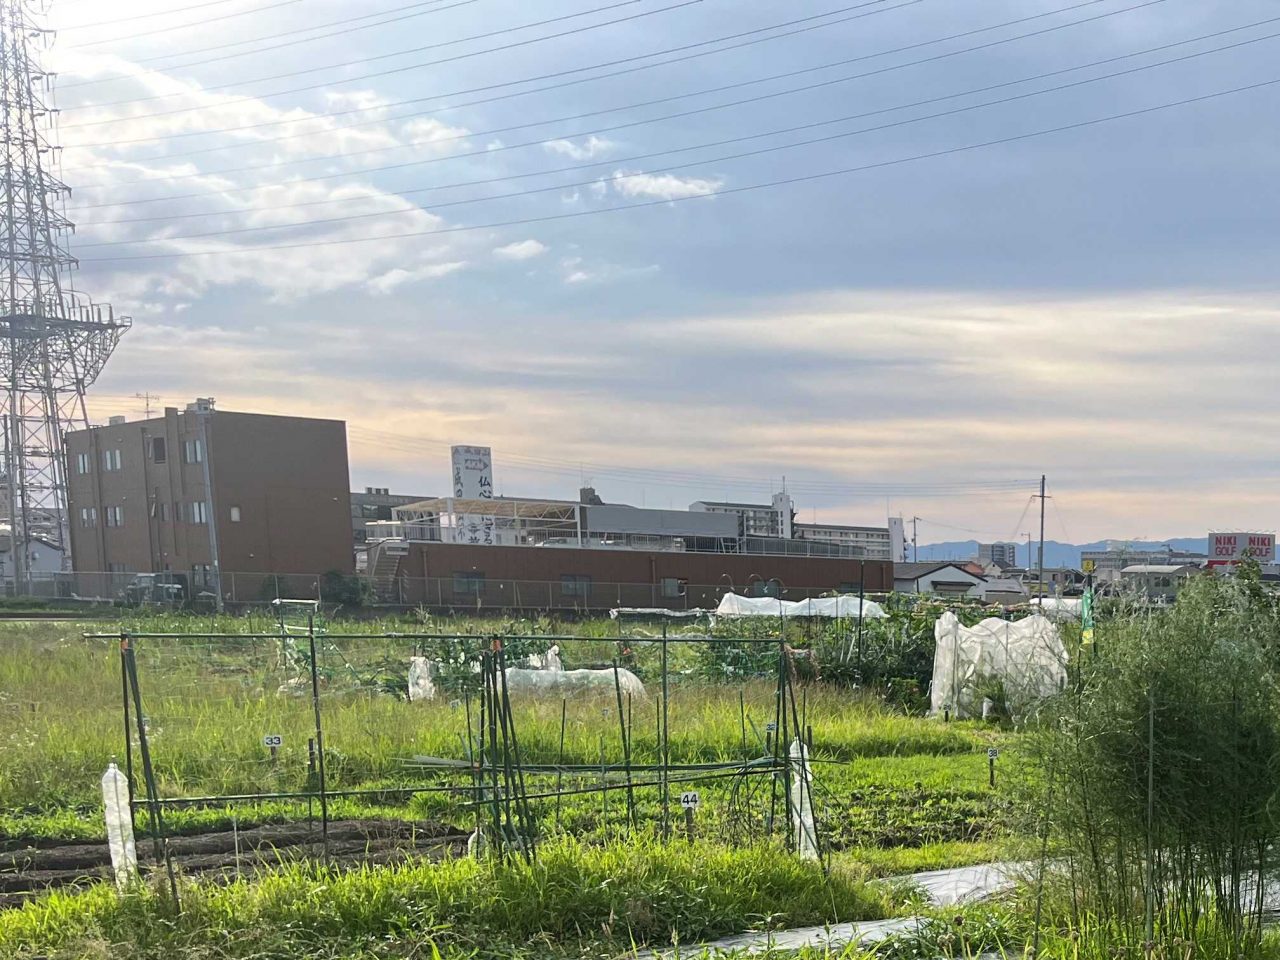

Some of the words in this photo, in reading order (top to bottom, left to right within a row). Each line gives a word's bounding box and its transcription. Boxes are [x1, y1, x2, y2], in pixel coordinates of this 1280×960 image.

[1215, 536, 1237, 546] NIKI
[1248, 536, 1271, 547] NIKI
[1215, 547, 1237, 556] GOLF
[265, 736, 281, 746] 33
[682, 794, 698, 805] 44
